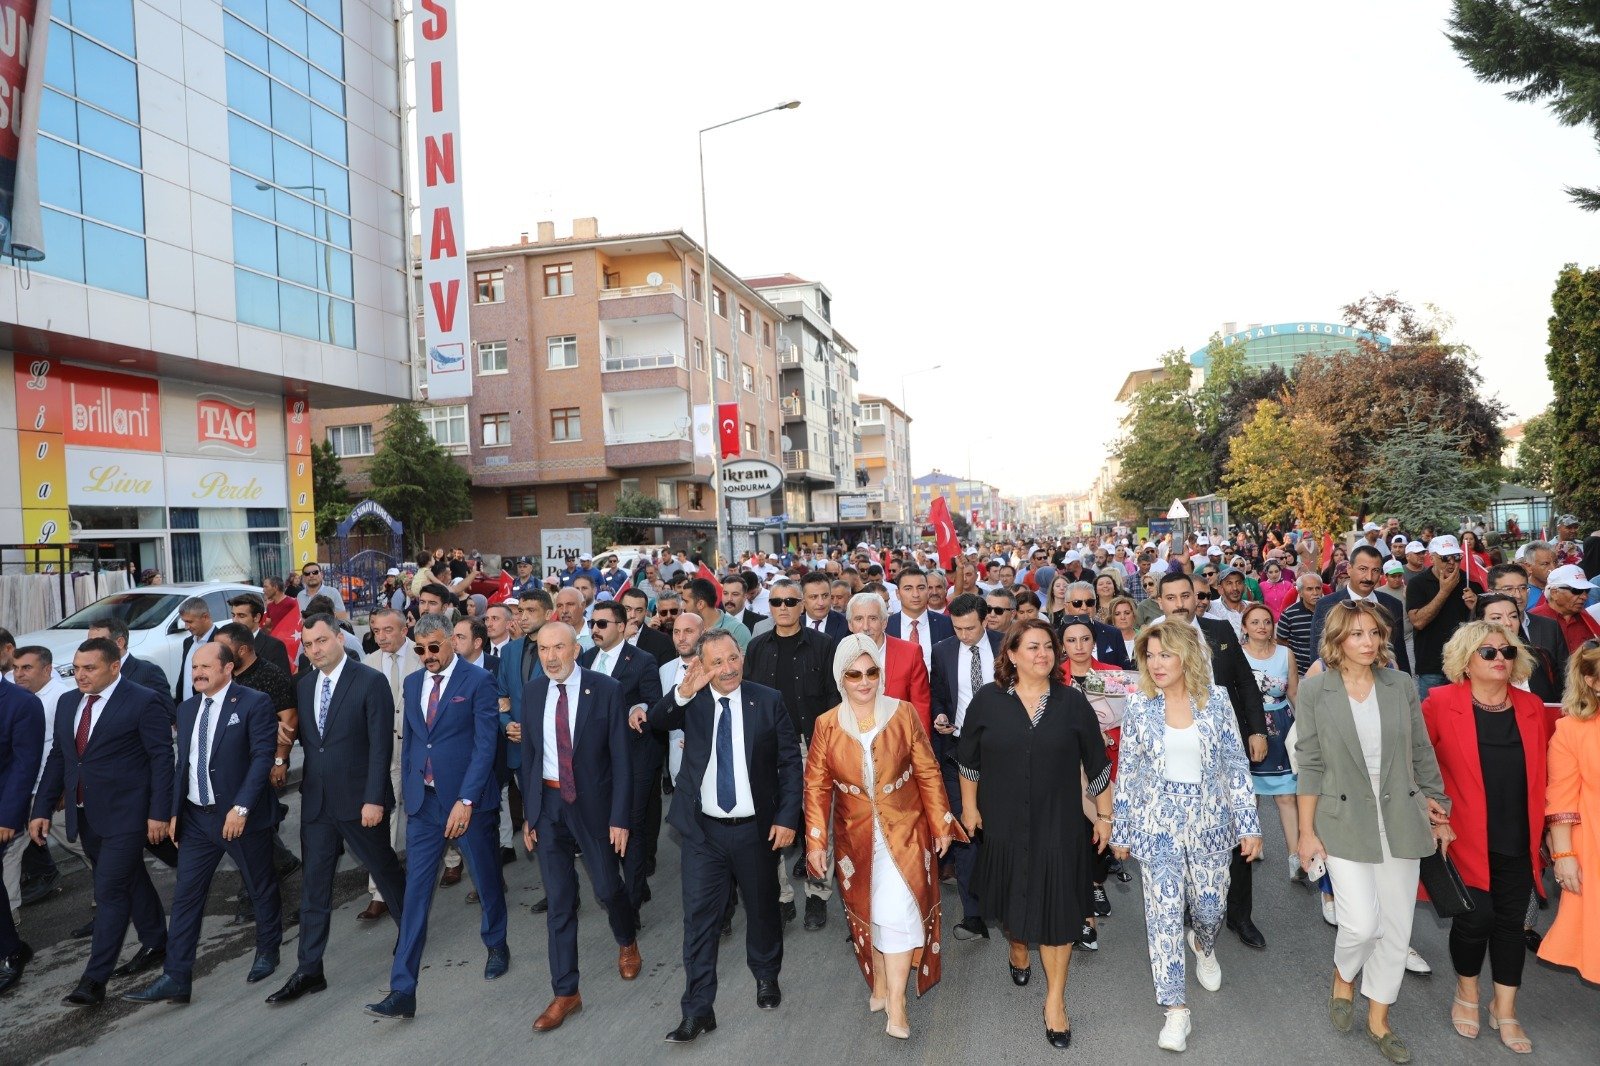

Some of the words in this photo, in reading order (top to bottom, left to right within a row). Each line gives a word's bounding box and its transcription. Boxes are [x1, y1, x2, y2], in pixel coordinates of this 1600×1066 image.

[421, 0, 460, 333] SINAV
[1297, 323, 1359, 337] GROUP
[70, 383, 150, 437] brillant
[200, 405, 253, 448] TAÇ
[82, 464, 153, 495] Liva
[191, 471, 263, 501] Perde
[546, 544, 580, 560] Liva
